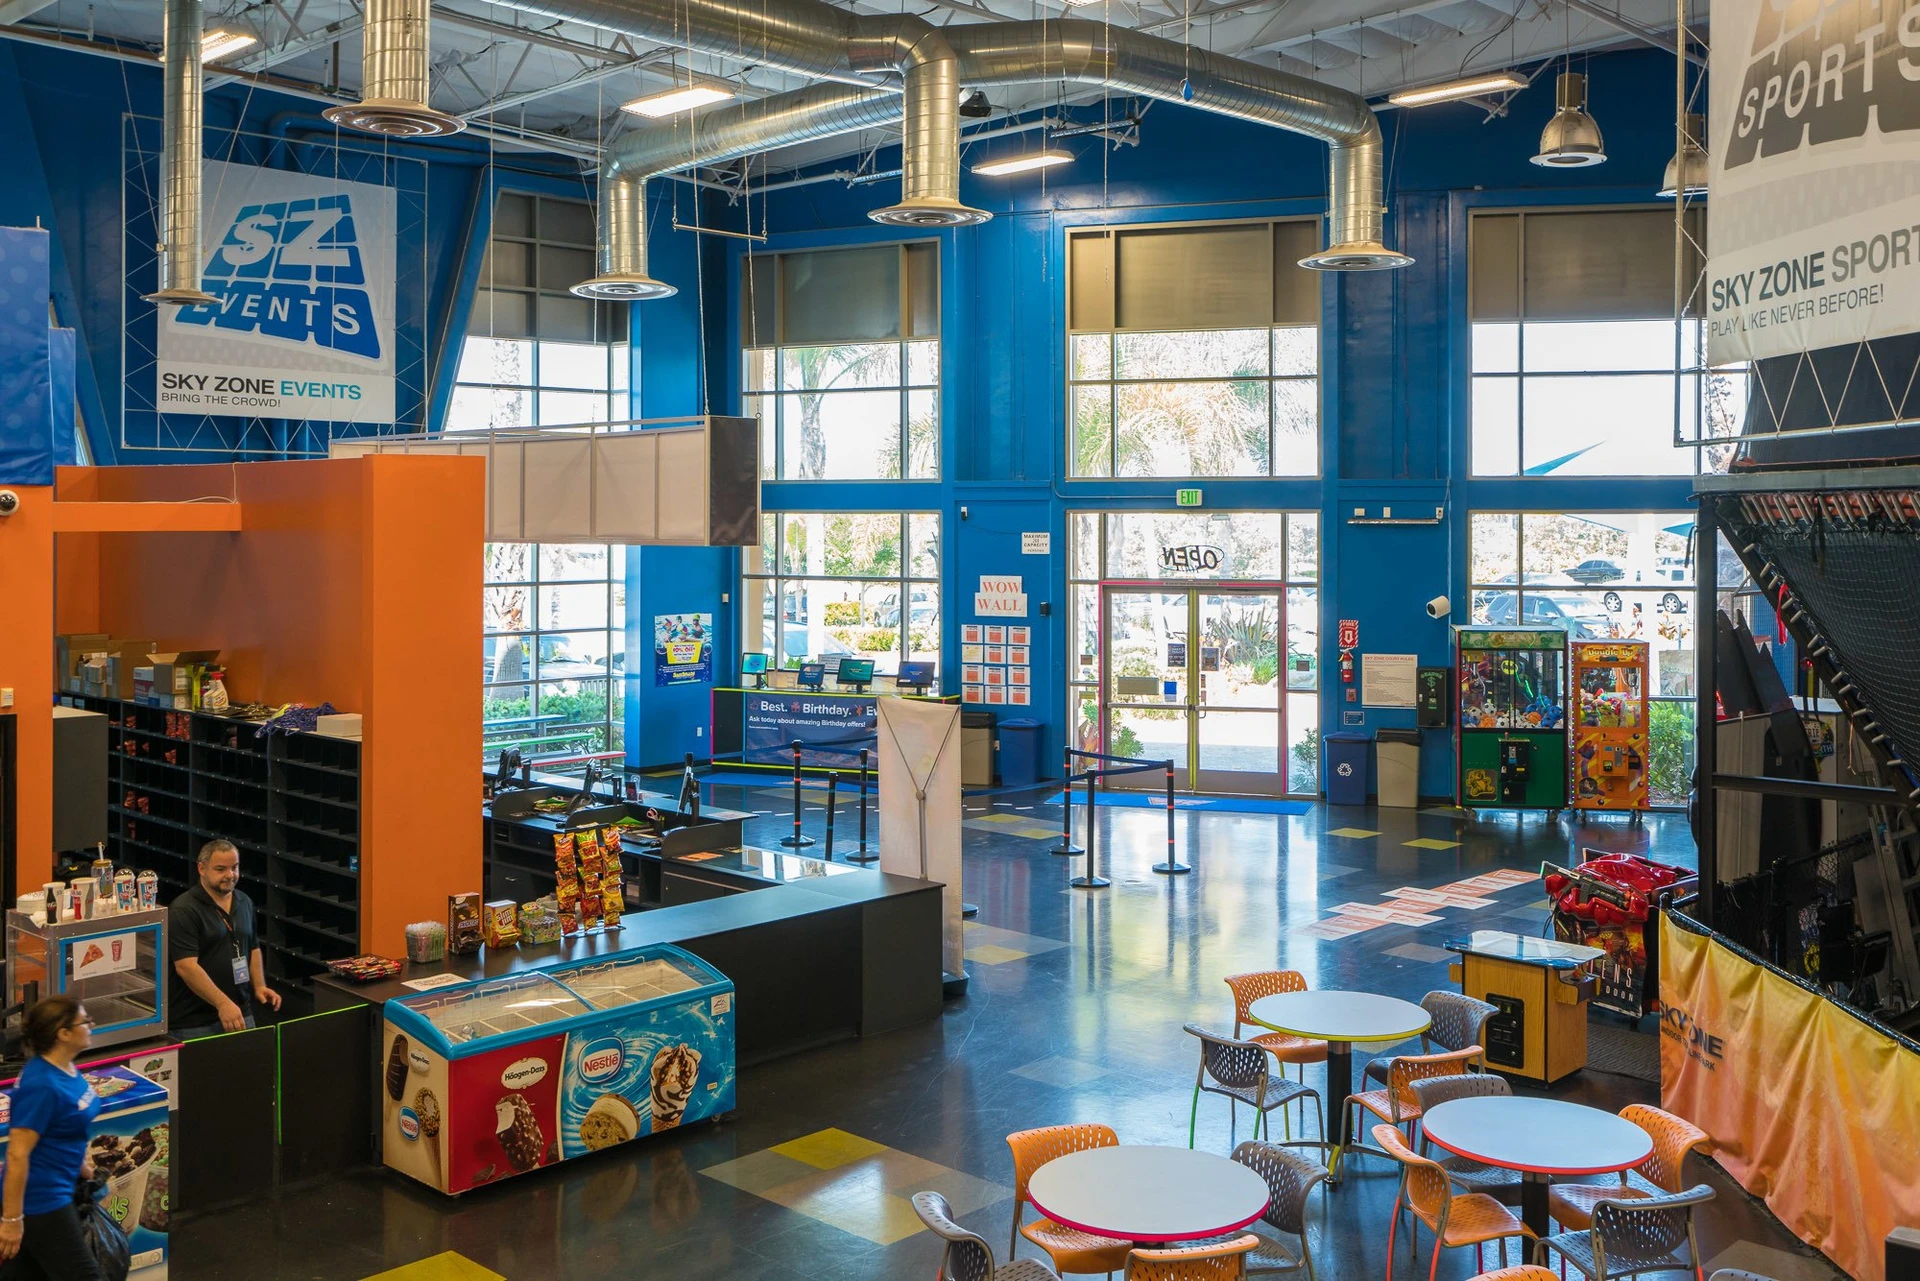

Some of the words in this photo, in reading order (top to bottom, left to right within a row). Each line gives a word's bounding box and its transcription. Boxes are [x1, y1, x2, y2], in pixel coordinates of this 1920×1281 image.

[1738, 3, 1920, 138] SPORTS
[222, 207, 351, 266] SZ
[1712, 271, 1755, 313] SKY
[1758, 251, 1825, 301] ZONE
[193, 291, 361, 335] EVENTS
[1711, 316, 1739, 338] PLAY
[1742, 311, 1767, 332] LIKE
[1770, 299, 1815, 325] NEVER
[1819, 283, 1884, 316] BEFORE!
[161, 392, 201, 404] BRING
[204, 395, 229, 405] THE
[231, 396, 281, 408] CROWD!
[162, 372, 209, 391] SKY
[214, 376, 275, 395] ZONE
[280, 380, 362, 400] EVENTS
[1180, 491, 1198, 504] EXIT
[982, 581, 1021, 594] WOW
[977, 598, 1021, 611] WALL
[760, 700, 788, 712] Best.
[802, 703, 851, 717] Birthday.
[761, 716, 776, 724] today
[796, 718, 820, 727] amazing
[821, 719, 846, 728] Birthday
[847, 720, 866, 728] offers!
[1587, 959, 1633, 988] IENS
[1689, 1017, 1724, 1059] ONE
